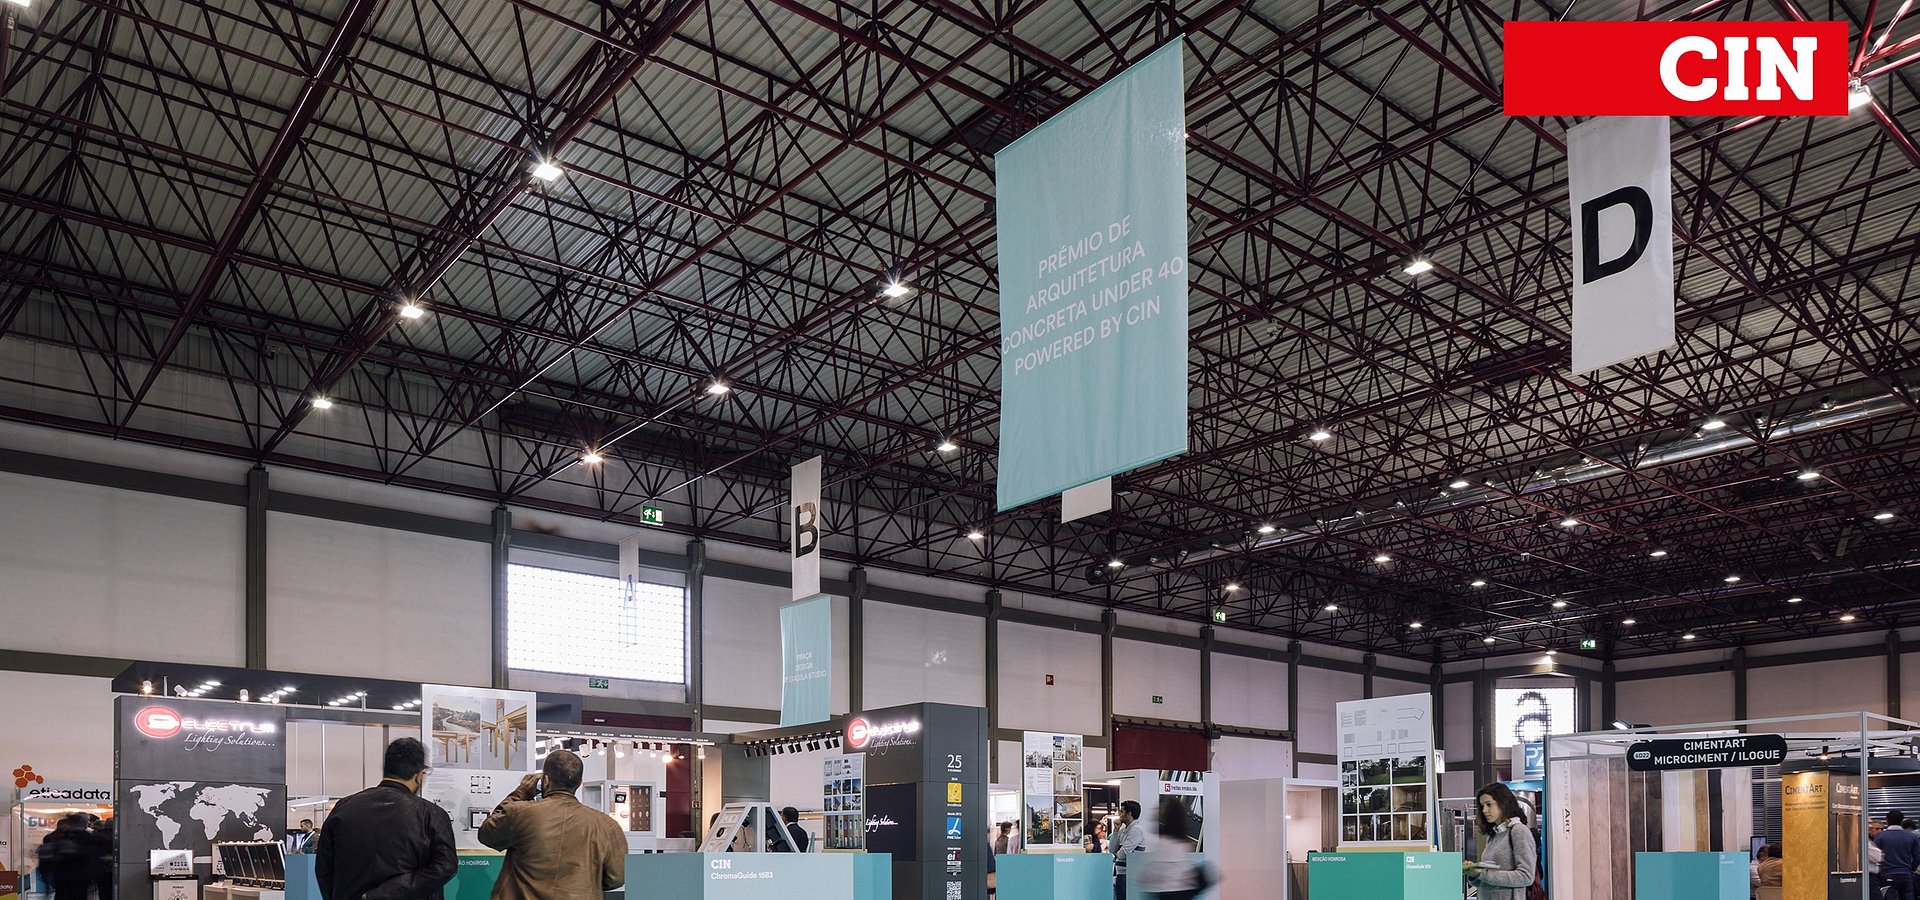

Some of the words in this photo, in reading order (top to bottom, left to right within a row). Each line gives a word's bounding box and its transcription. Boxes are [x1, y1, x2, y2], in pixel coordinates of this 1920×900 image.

[1581, 185, 1653, 285] D
[1038, 231, 1103, 279] PRÉMIO
[1108, 215, 1131, 243] DE
[1026, 240, 1145, 314] ARQUITETURA
[1002, 300, 1087, 355] CONCRETA
[1092, 268, 1153, 311] UNDER
[1158, 256, 1184, 279] 40
[1015, 327, 1094, 376] POWERED
[1100, 313, 1123, 339] BY
[1127, 296, 1160, 325] CIN
[795, 501, 818, 559] B
[623, 574, 636, 610] A
[796, 662, 813, 671] DESIGN
[808, 669, 826, 680] STUDIO
[184, 729, 223, 751] Lighting
[1684, 738, 1747, 751] CIMENTART
[947, 754, 962, 769] 25
[1654, 753, 1728, 765] MICROCIMENT
[1731, 752, 1736, 762] /
[1739, 750, 1780, 761] ILOGUE
[29, 787, 110, 800] eticadata
[711, 859, 731, 869] CIN
[711, 871, 757, 879] ChromaGuide
